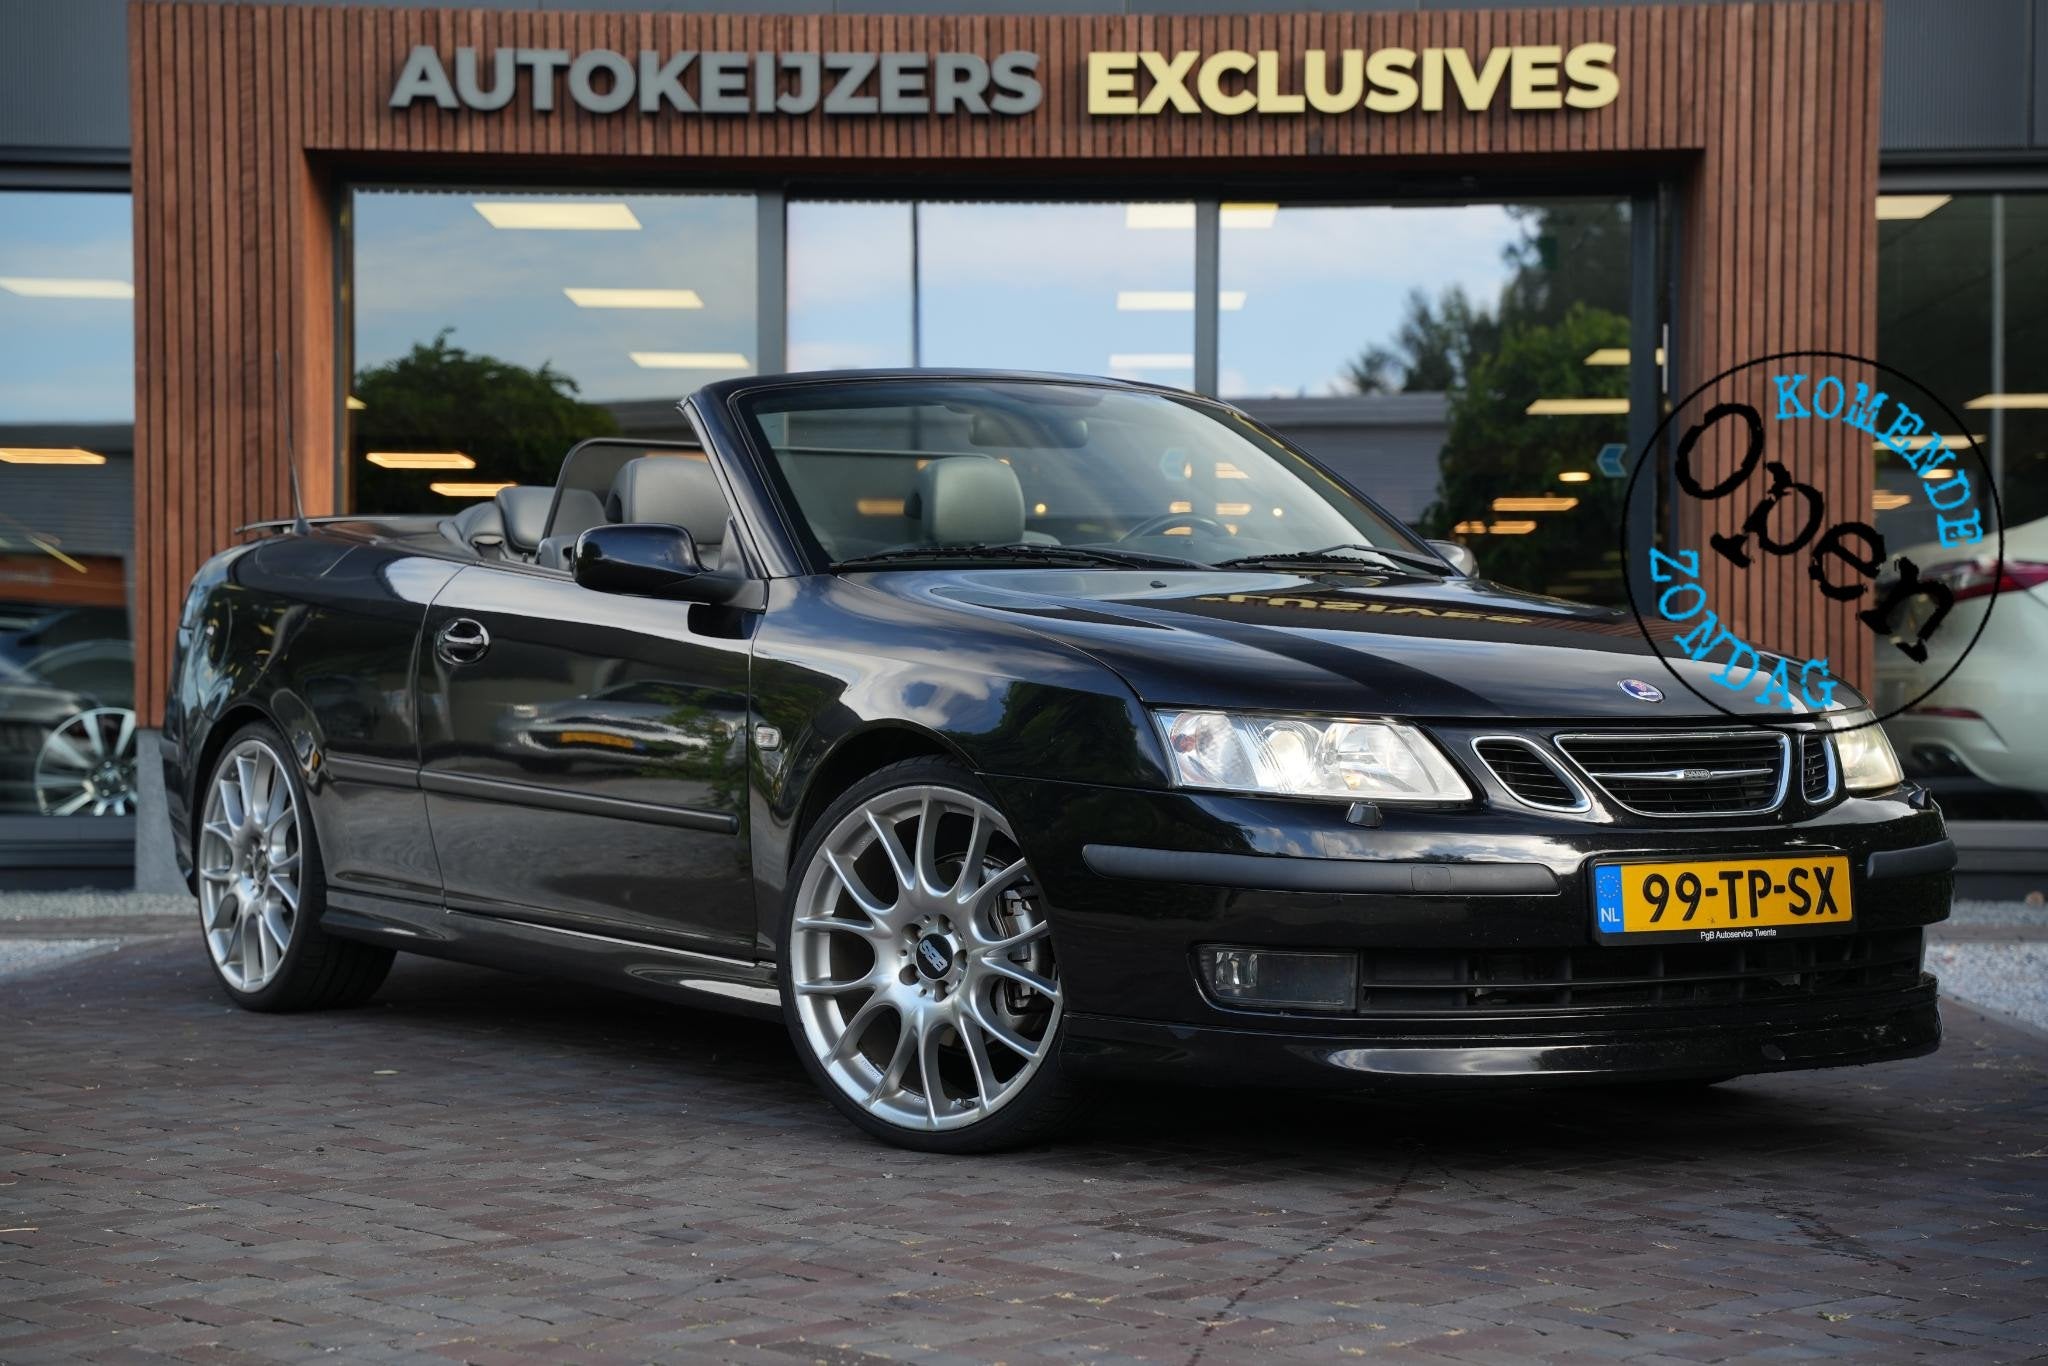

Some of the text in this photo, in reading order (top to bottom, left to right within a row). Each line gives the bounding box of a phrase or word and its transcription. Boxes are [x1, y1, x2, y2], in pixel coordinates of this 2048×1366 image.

[388, 43, 1620, 115] AUTOKEIJZERS EXCLUSIVES
[1642, 866, 1839, 923] 99-TP-SX
[1600, 907, 1621, 923] NL
[1700, 928, 1777, 941] PgB Autoservice Twente
[920, 939, 949, 973] BBS
